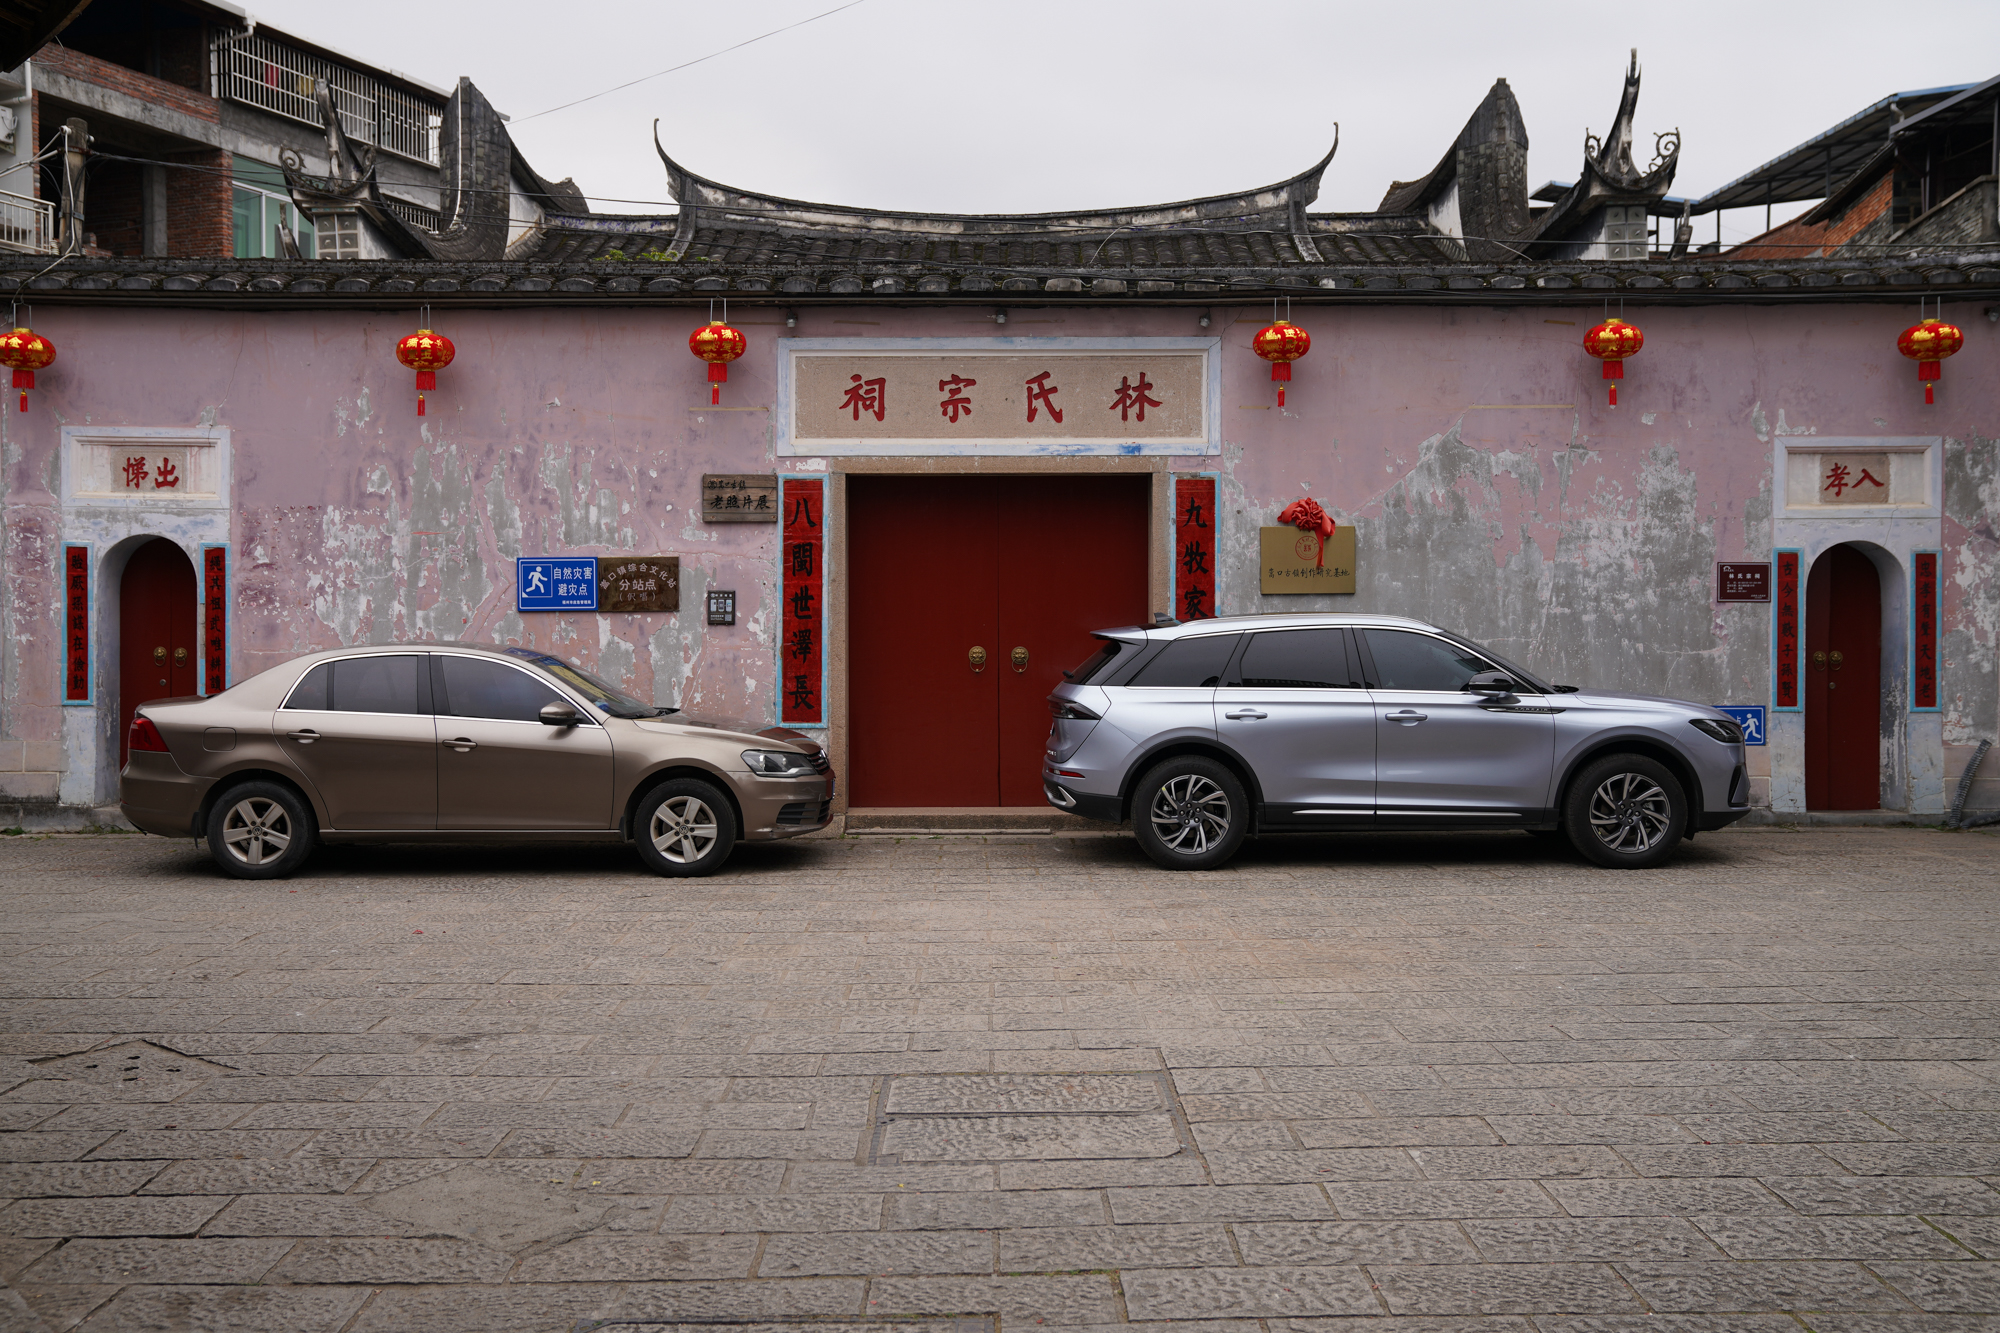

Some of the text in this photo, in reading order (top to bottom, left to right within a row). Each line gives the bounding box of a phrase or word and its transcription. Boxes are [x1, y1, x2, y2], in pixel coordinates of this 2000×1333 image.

[839, 371, 1163, 424] 林氏宗祠
[122, 456, 180, 490] 出悌
[1824, 462, 1885, 497] 入孝
[710, 494, 771, 510] 老照片展
[1183, 496, 1209, 619] 九牧家
[553, 567, 593, 580] 自然灾害
[599, 563, 677, 590] 嵩口镇综合文化站
[618, 579, 657, 591] 分站点
[557, 583, 588, 596] 避灾点
